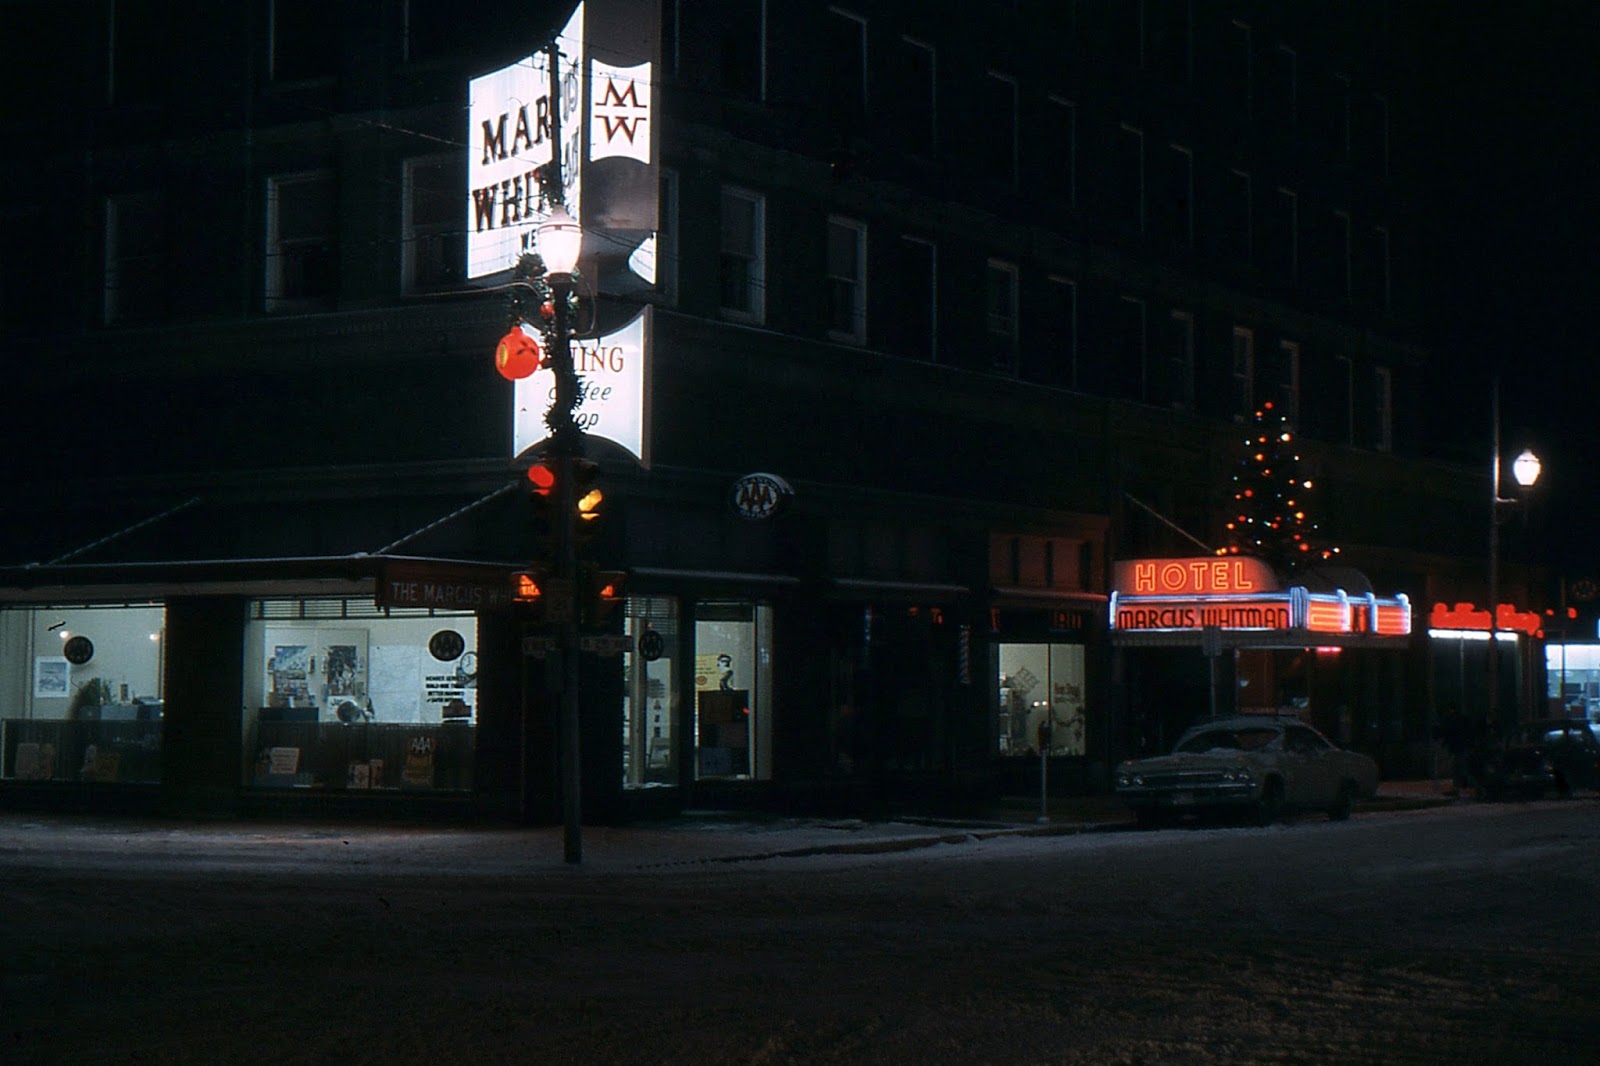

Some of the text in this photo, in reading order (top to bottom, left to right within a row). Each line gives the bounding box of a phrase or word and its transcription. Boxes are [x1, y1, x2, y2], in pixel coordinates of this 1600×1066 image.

[577, 411, 599, 430] op
[739, 481, 773, 511] AAA
[1135, 561, 1253, 592] HOTEL
[391, 582, 417, 601] THE
[424, 584, 482, 604] MARCUS
[1118, 607, 1290, 630] MARCUS WHITMAN
[412, 736, 431, 754] AAA
